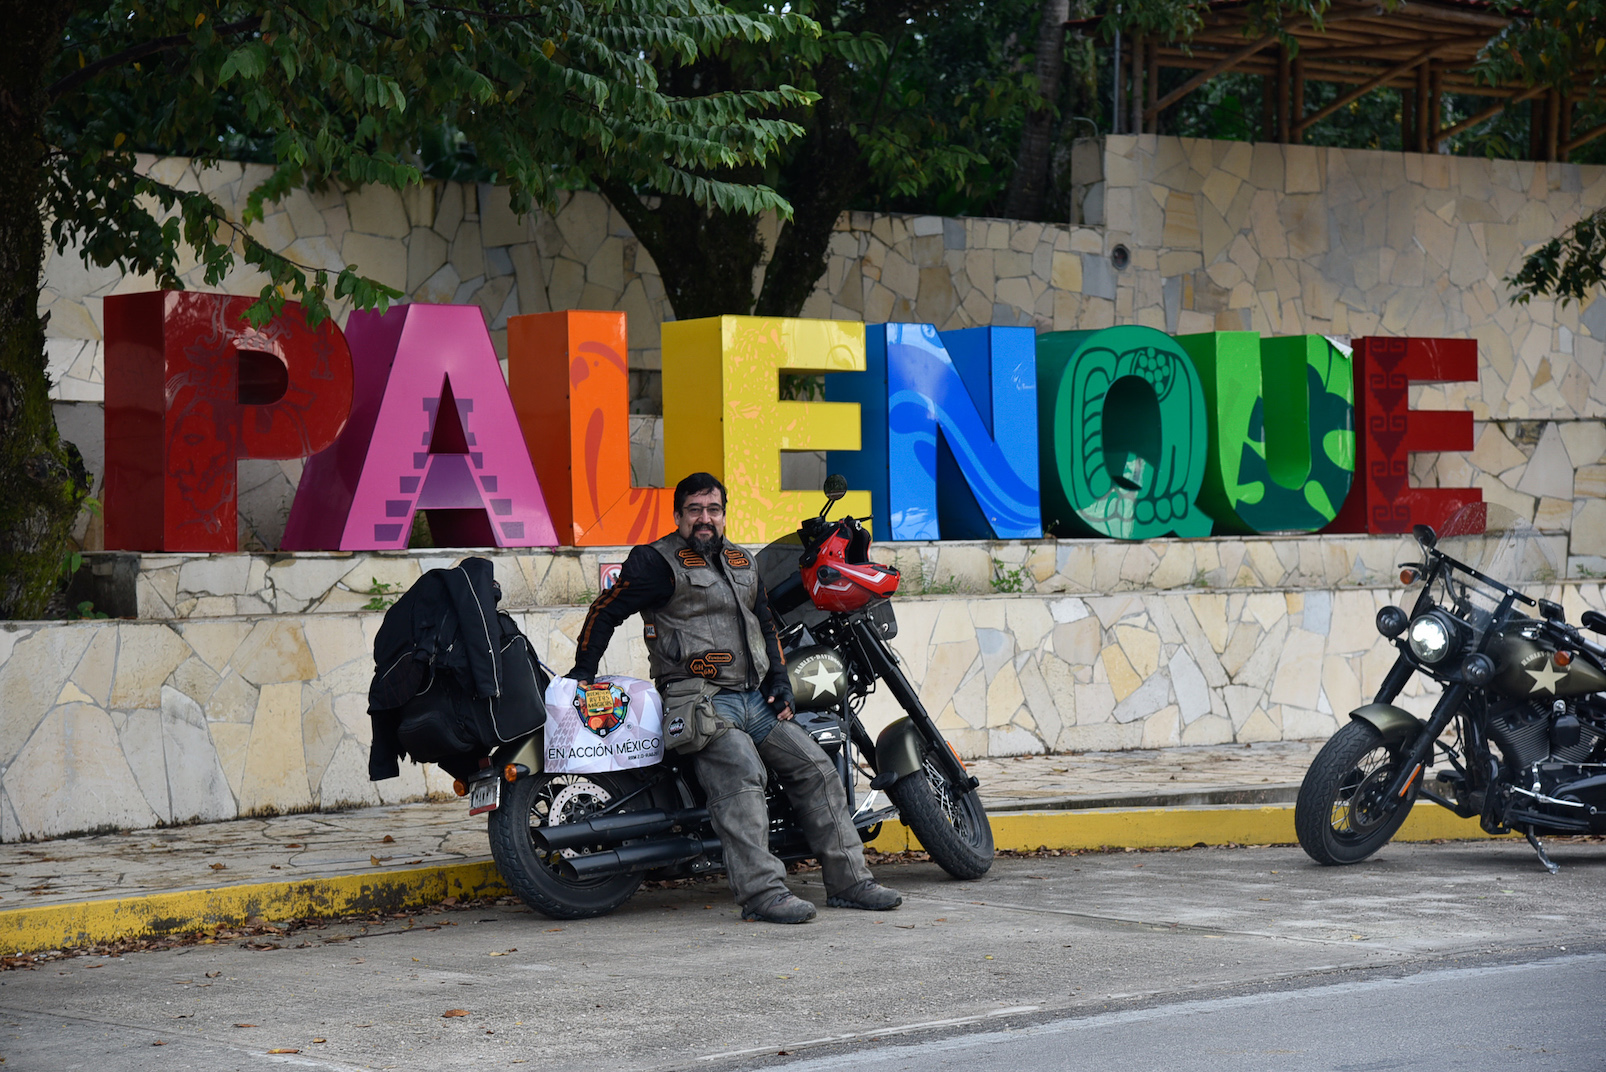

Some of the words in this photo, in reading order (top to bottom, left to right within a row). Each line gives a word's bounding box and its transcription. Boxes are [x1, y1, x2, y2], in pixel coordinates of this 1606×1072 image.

[104, 290, 1486, 554] PALENQUE
[794, 653, 844, 675] HARLEY-DAVIDSON
[548, 747, 568, 760] EN
[568, 743, 613, 759] ACCIÓN
[615, 737, 660, 755] MÉXICO
